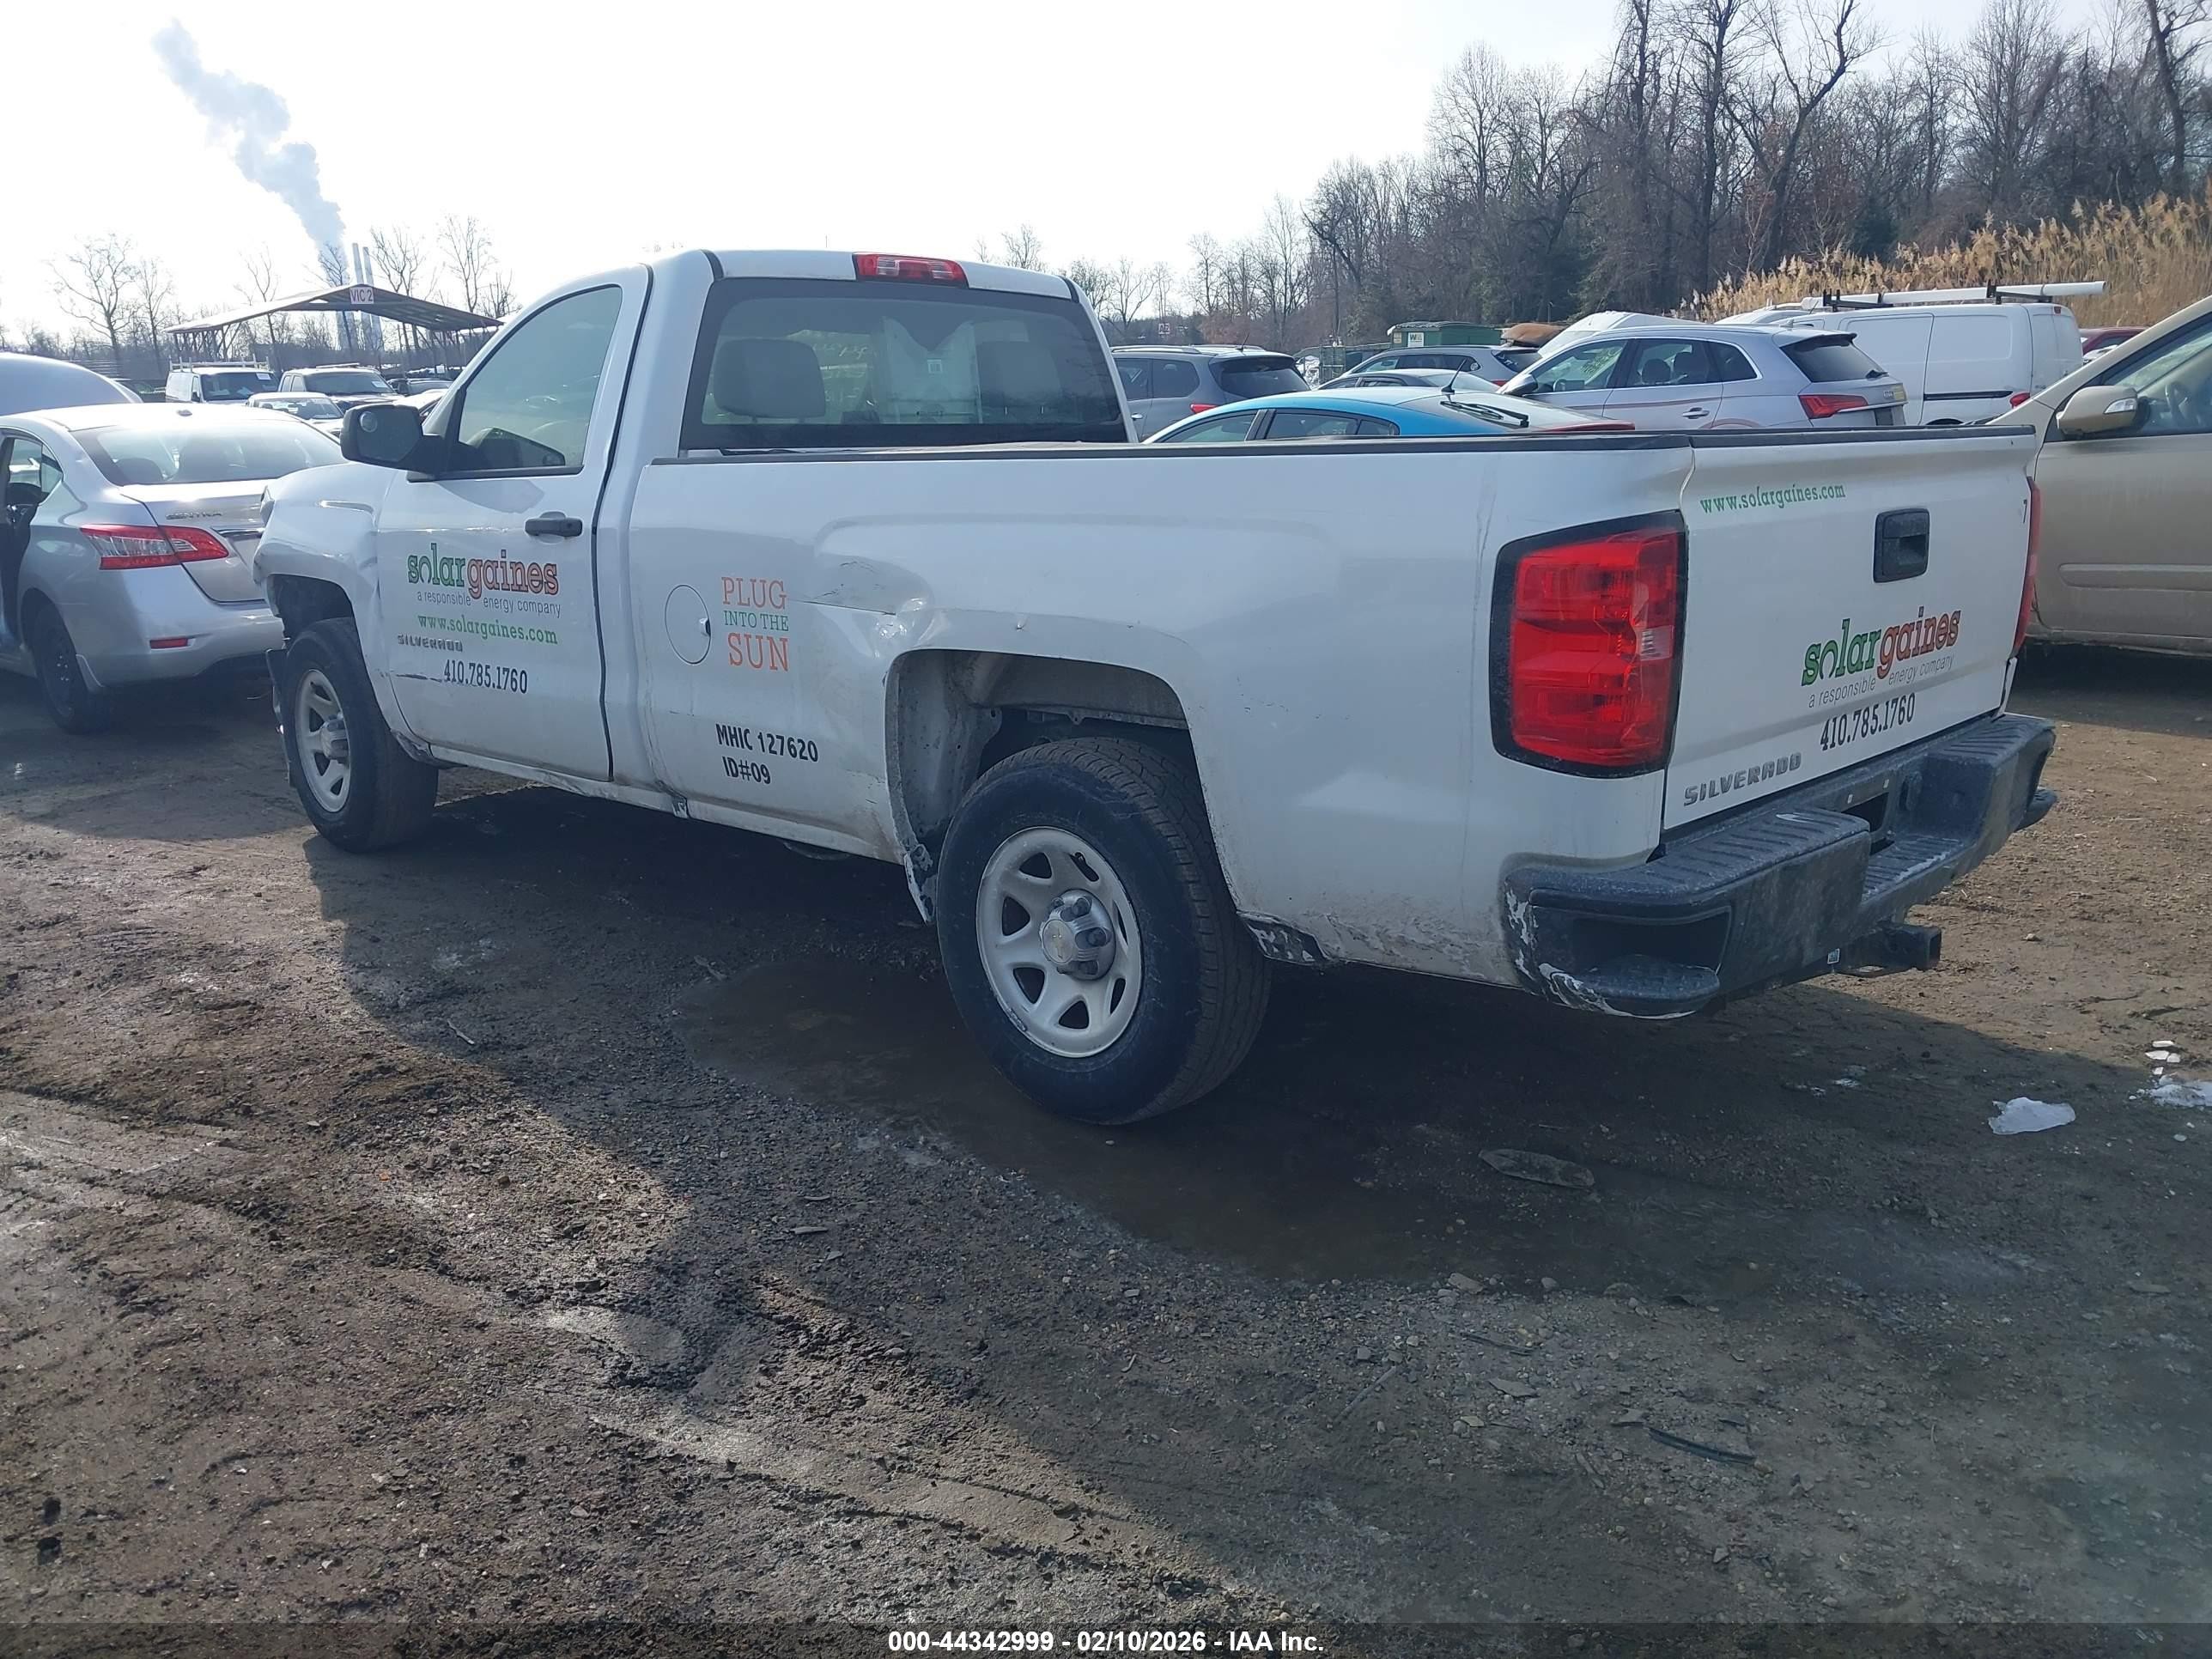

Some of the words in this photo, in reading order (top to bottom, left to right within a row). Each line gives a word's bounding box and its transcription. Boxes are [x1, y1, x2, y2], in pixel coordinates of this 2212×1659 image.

[350, 289, 366, 301] VIC
[368, 289, 373, 301] 2
[1700, 484, 1846, 514] www.solargaines.com
[408, 543, 558, 599] solargaines
[417, 591, 422, 601] a
[424, 592, 471, 606] responsible
[483, 596, 514, 613] energy
[517, 599, 561, 618] company
[721, 576, 787, 610] PLUG
[417, 614, 558, 645] www.solargaines.com
[724, 610, 757, 628] INTO
[760, 613, 789, 632] THE
[727, 632, 789, 672] SUN
[1801, 605, 1961, 687] solargaines
[444, 659, 527, 695] 410.785.1760
[1808, 693, 1814, 708] a
[1819, 677, 1876, 706] responsible
[1889, 665, 1917, 685] energy
[1919, 654, 1955, 677] company
[1820, 692, 1917, 752] 410.785.1760
[715, 723, 753, 750] MHIC
[757, 732, 818, 763] 127620
[722, 756, 771, 785] ID#09
[1684, 752, 1802, 807] SILVERADO
